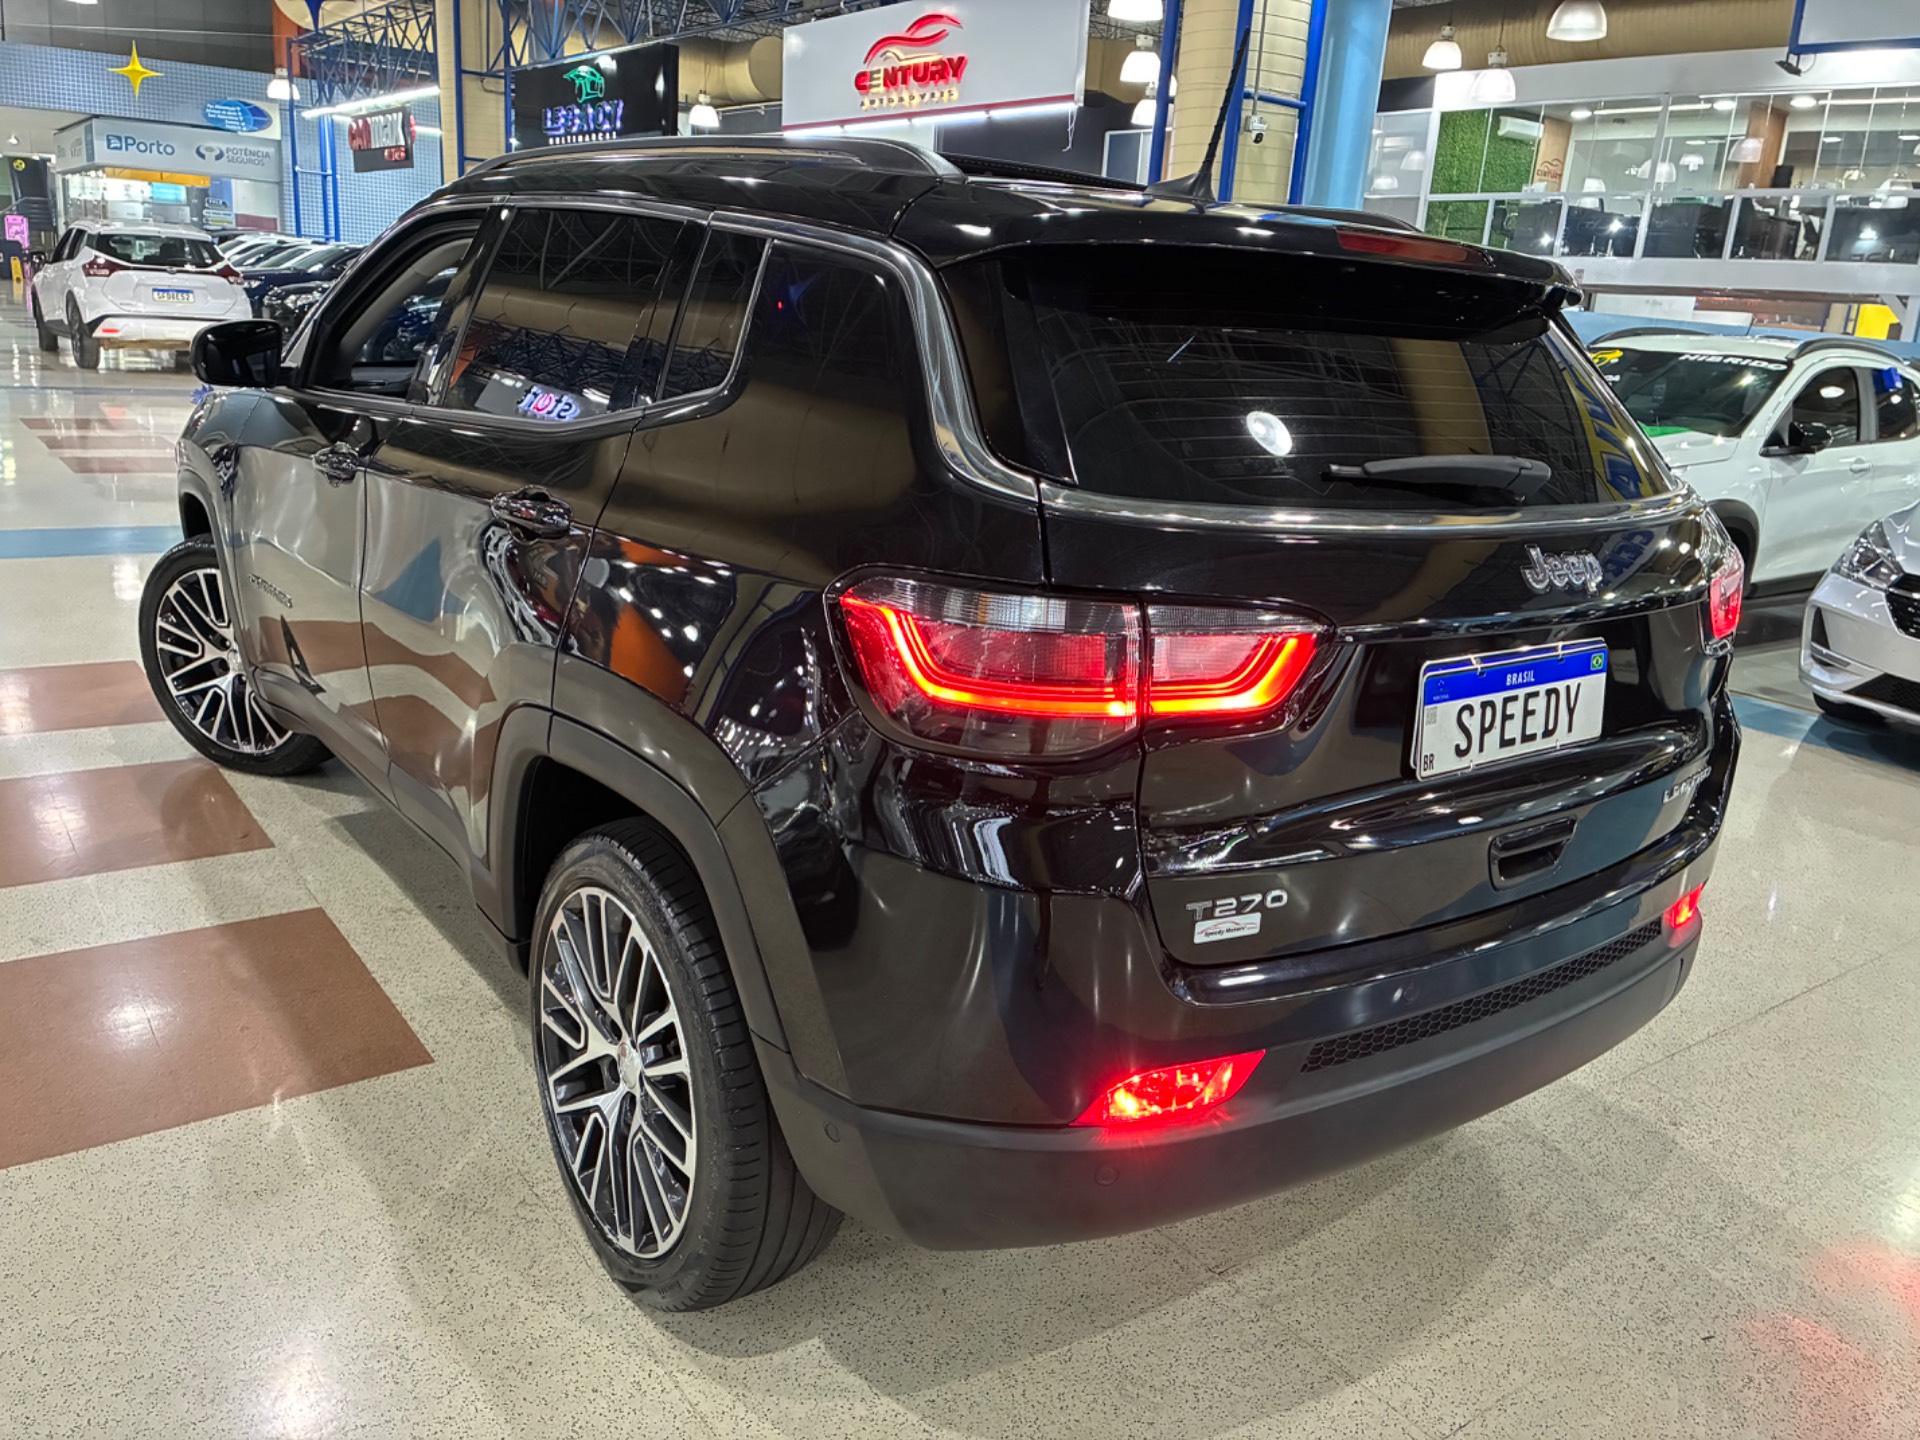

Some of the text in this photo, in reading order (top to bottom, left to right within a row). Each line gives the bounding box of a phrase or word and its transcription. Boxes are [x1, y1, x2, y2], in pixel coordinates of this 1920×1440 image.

[854, 55, 967, 93] CENTURY
[124, 136, 175, 156] Porto
[1520, 543, 1603, 597] Jeep
[1506, 670, 1535, 686] BRASIL
[1455, 682, 1581, 758] SPEEDY
[1423, 754, 1435, 771] BR
[1186, 889, 1288, 921] T270
